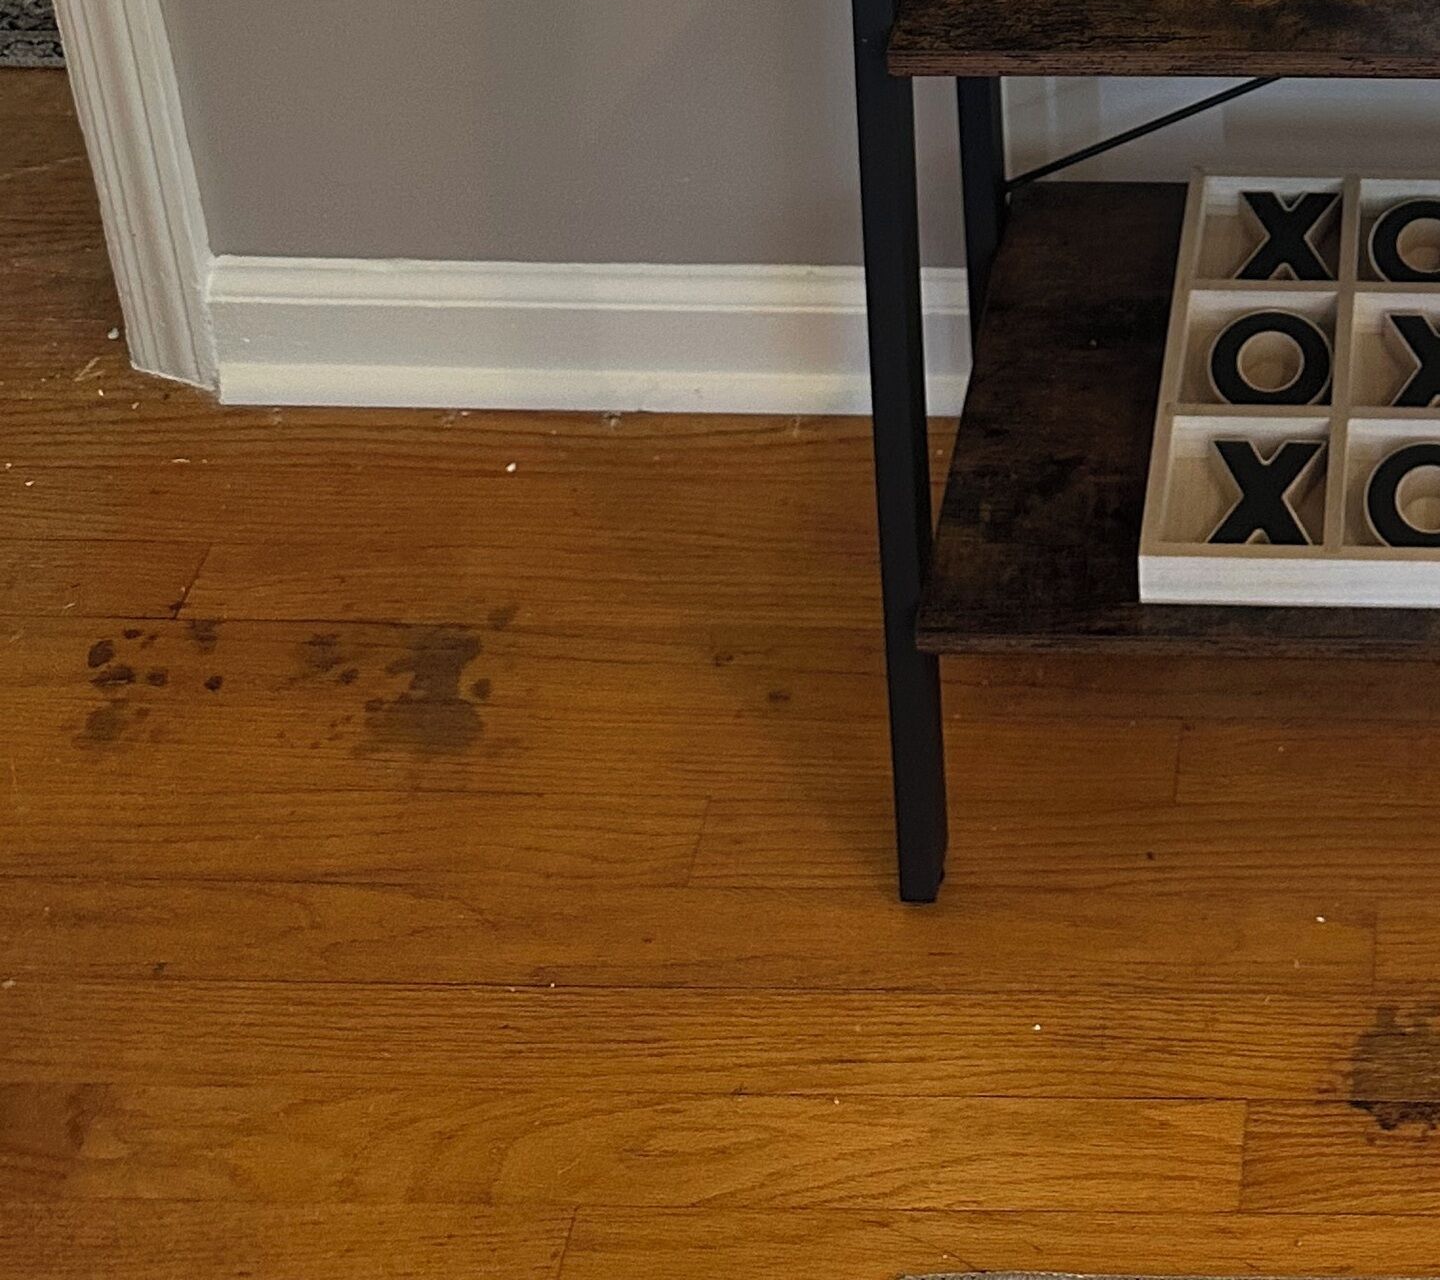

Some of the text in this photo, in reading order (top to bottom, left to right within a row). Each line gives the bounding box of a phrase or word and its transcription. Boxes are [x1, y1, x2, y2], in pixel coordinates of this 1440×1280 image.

[1236, 191, 1341, 281] X
[1208, 309, 1333, 406] O
[1207, 439, 1328, 545] X
